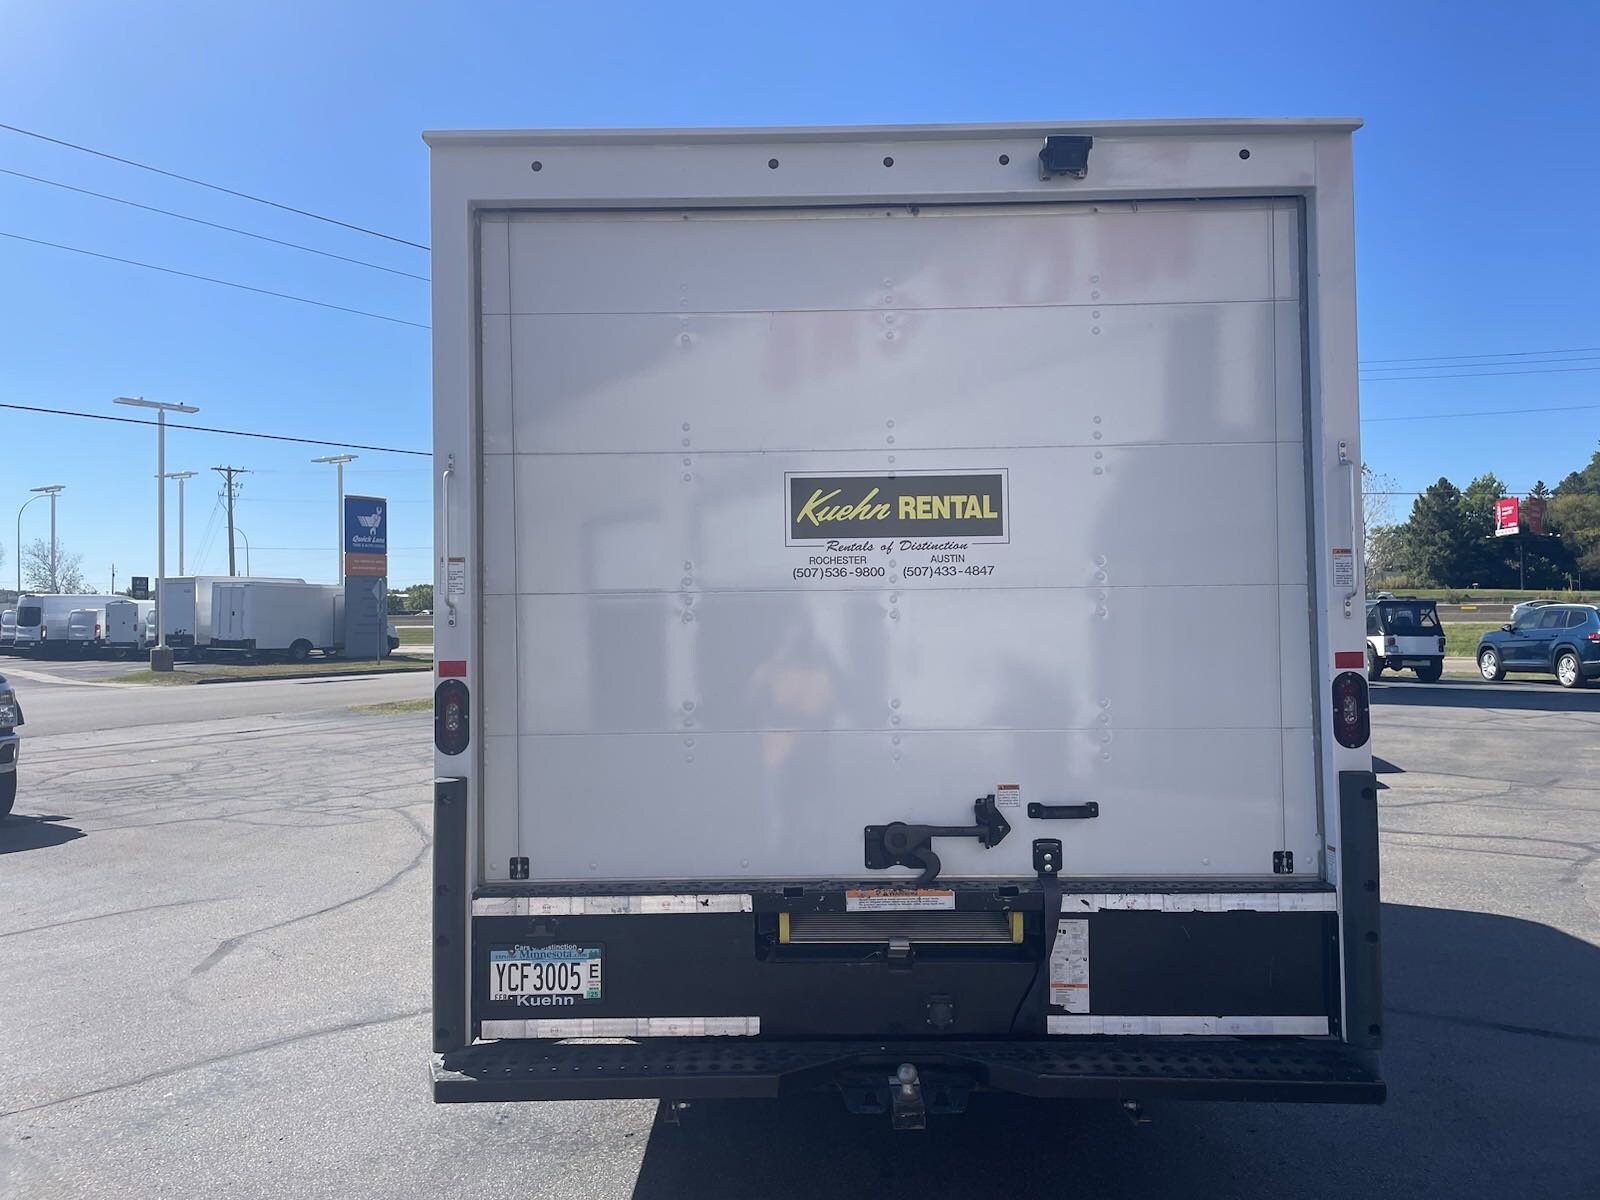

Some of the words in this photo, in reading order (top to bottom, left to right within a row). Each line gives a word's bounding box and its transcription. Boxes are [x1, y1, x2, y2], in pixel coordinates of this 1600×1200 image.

[796, 487, 891, 527] Kuehn
[898, 495, 998, 520] RENTAL
[352, 535, 372, 543] Quick
[826, 540, 874, 552] Rentals
[880, 541, 894, 555] of
[899, 540, 968, 552] Distinction
[809, 556, 867, 565] ROCHESTER
[930, 554, 965, 563] AUSTIN
[792, 567, 885, 580] (507)536-9800
[903, 566, 995, 578] (507)433-4847
[496, 963, 581, 992] YCF3005
[590, 964, 599, 979] E
[517, 995, 574, 1007] Kuehn
